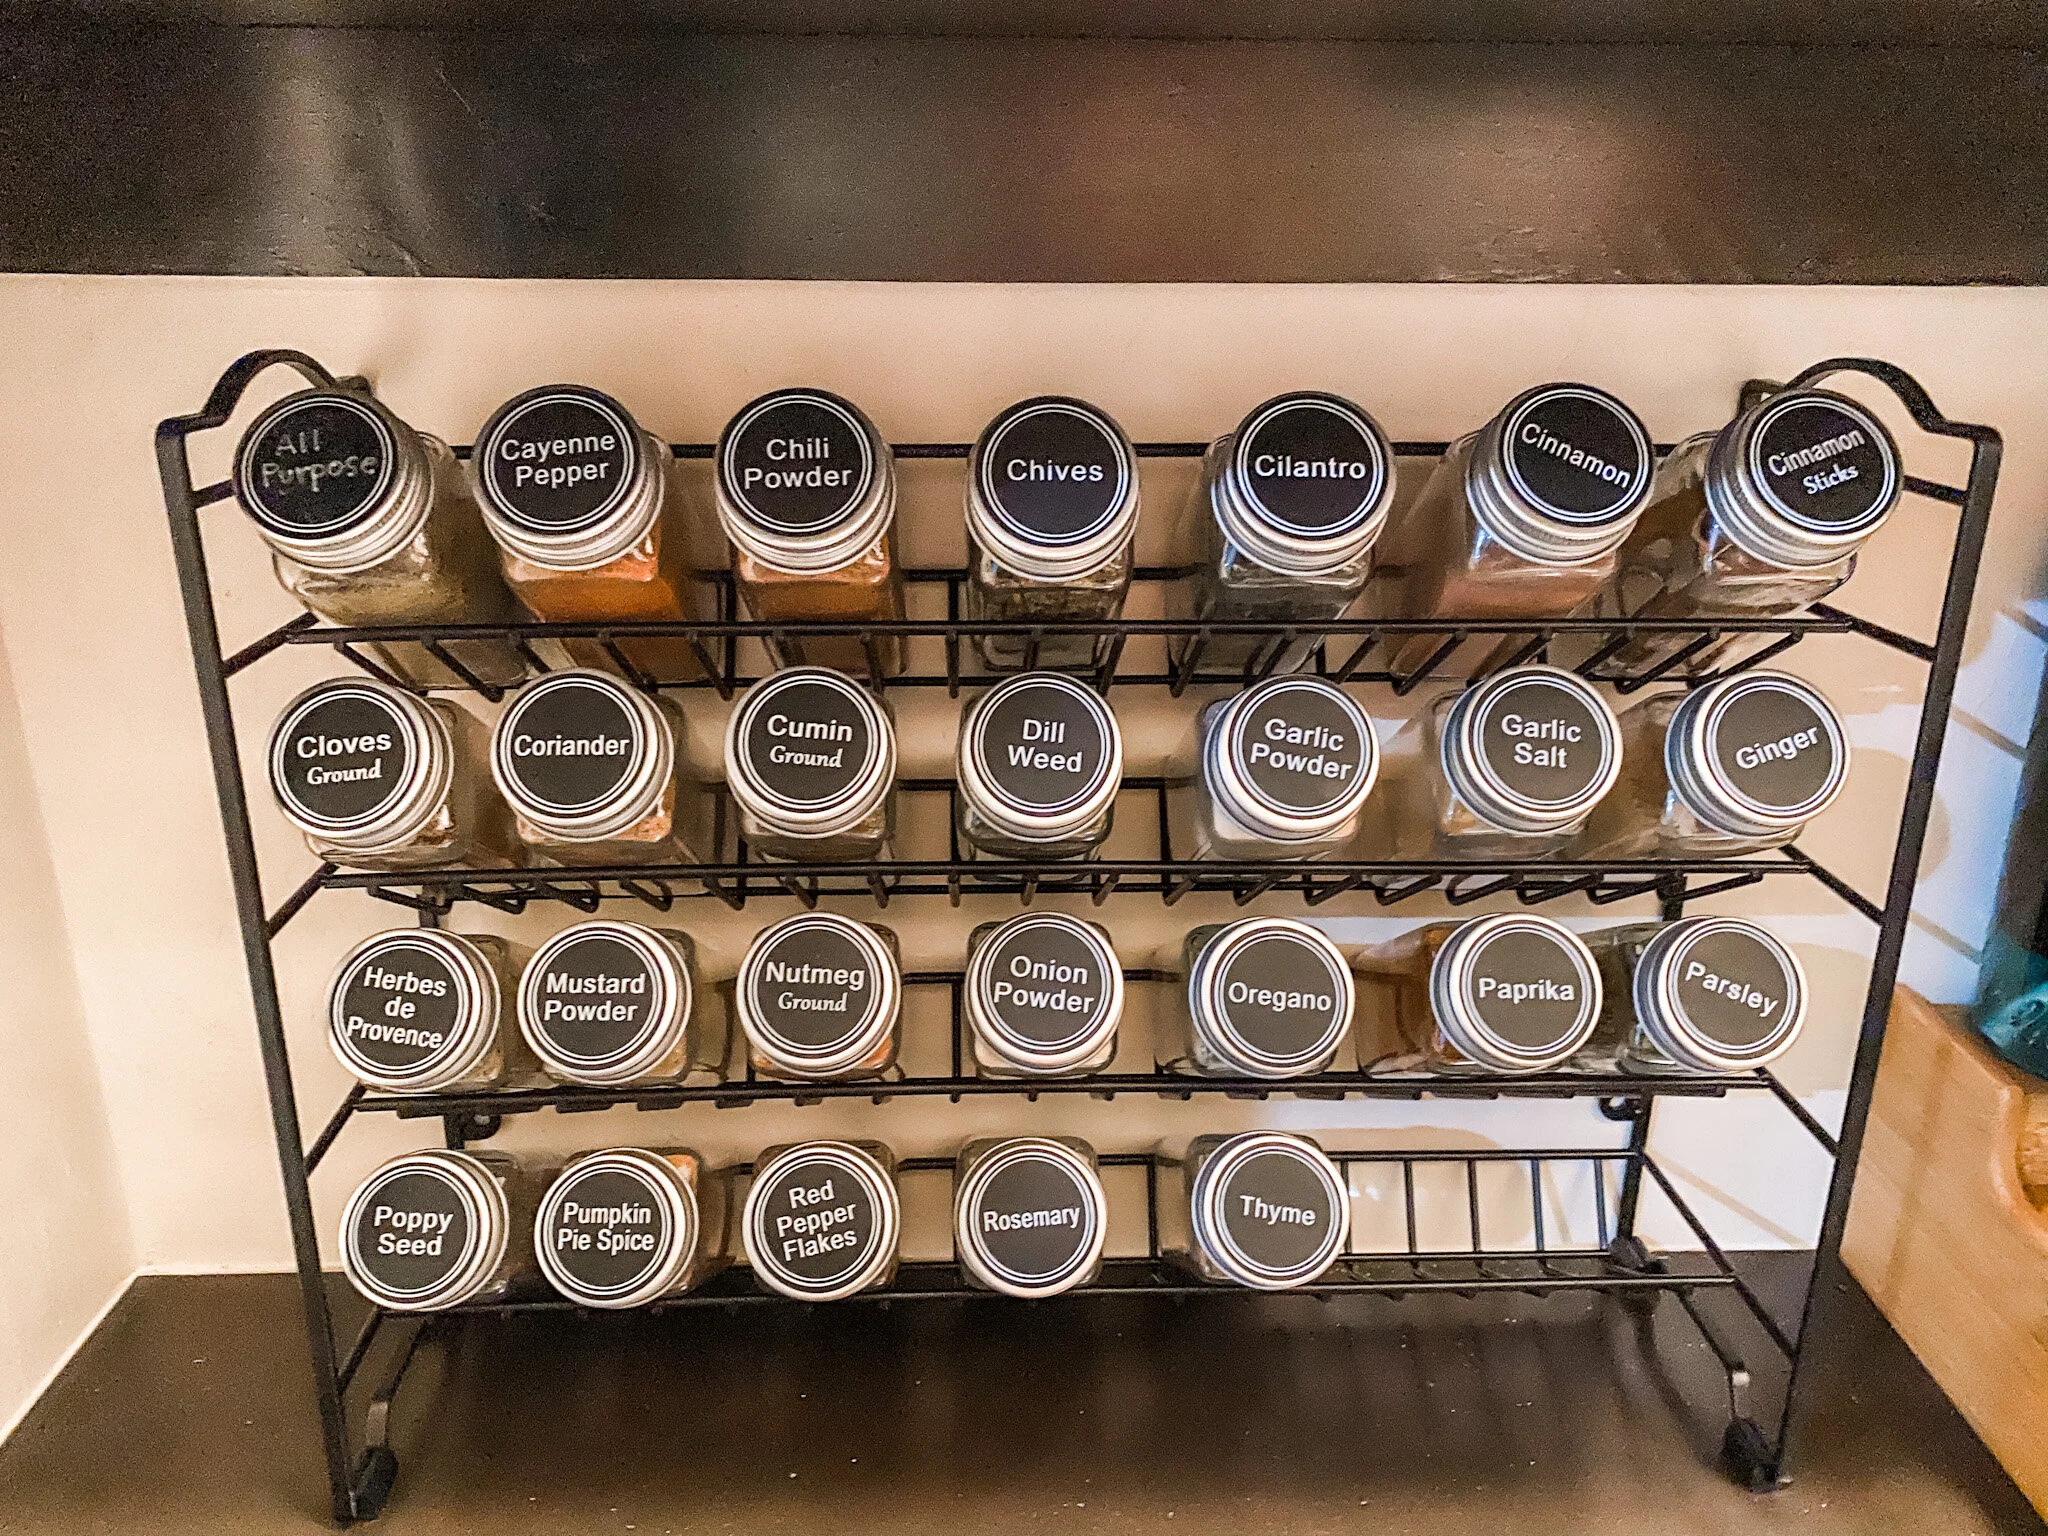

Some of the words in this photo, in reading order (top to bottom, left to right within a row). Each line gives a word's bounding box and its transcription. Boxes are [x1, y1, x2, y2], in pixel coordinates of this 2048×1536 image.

[275, 428, 321, 457] All
[500, 434, 616, 463] Cayenne
[766, 437, 829, 461] Chili
[1521, 423, 1631, 489] Cinnamon
[1768, 429, 1866, 477] Cinnamon
[261, 456, 378, 493] Purpose
[515, 462, 610, 489] Pepper
[744, 465, 853, 490] Powder
[1007, 458, 1104, 482] Chives
[1254, 454, 1366, 479] Cilantro
[1802, 463, 1859, 495] Sticks
[767, 714, 853, 742] Cumin
[1022, 718, 1066, 744] Dill
[1264, 718, 1344, 752] Garlic
[1501, 714, 1582, 743] Garlic
[296, 733, 392, 759] Cloves
[513, 734, 631, 757] Coriander
[769, 745, 844, 768] Ground
[1007, 744, 1083, 773] Weed
[1513, 742, 1568, 769] Salt
[1735, 726, 1818, 769] Ginger
[306, 757, 383, 785] Ground
[1250, 742, 1353, 780] Powder
[363, 965, 447, 997] Herbes
[545, 972, 646, 995] Mustard
[765, 961, 866, 992] Nutmeg
[1010, 955, 1088, 985] Onion
[777, 991, 848, 1012] Ground
[993, 981, 1095, 1014] Powder
[1228, 981, 1332, 1012] Oregano
[1478, 977, 1575, 1005] Paprika
[1685, 961, 1779, 1018] Parsley
[384, 995, 416, 1020] de
[543, 999, 639, 1022] Powder
[346, 1015, 443, 1049] Provence
[788, 1179, 835, 1209] Red
[373, 1205, 454, 1235] Poppy
[563, 1201, 652, 1230] Pumpkin
[776, 1203, 857, 1238] Pepper
[983, 1207, 1081, 1232] Rosemary
[1239, 1195, 1316, 1226] Thyme
[377, 1232, 443, 1256] Seed
[557, 1228, 592, 1251] Pie
[596, 1228, 655, 1256] Spice
[782, 1230, 858, 1262] Flakes
